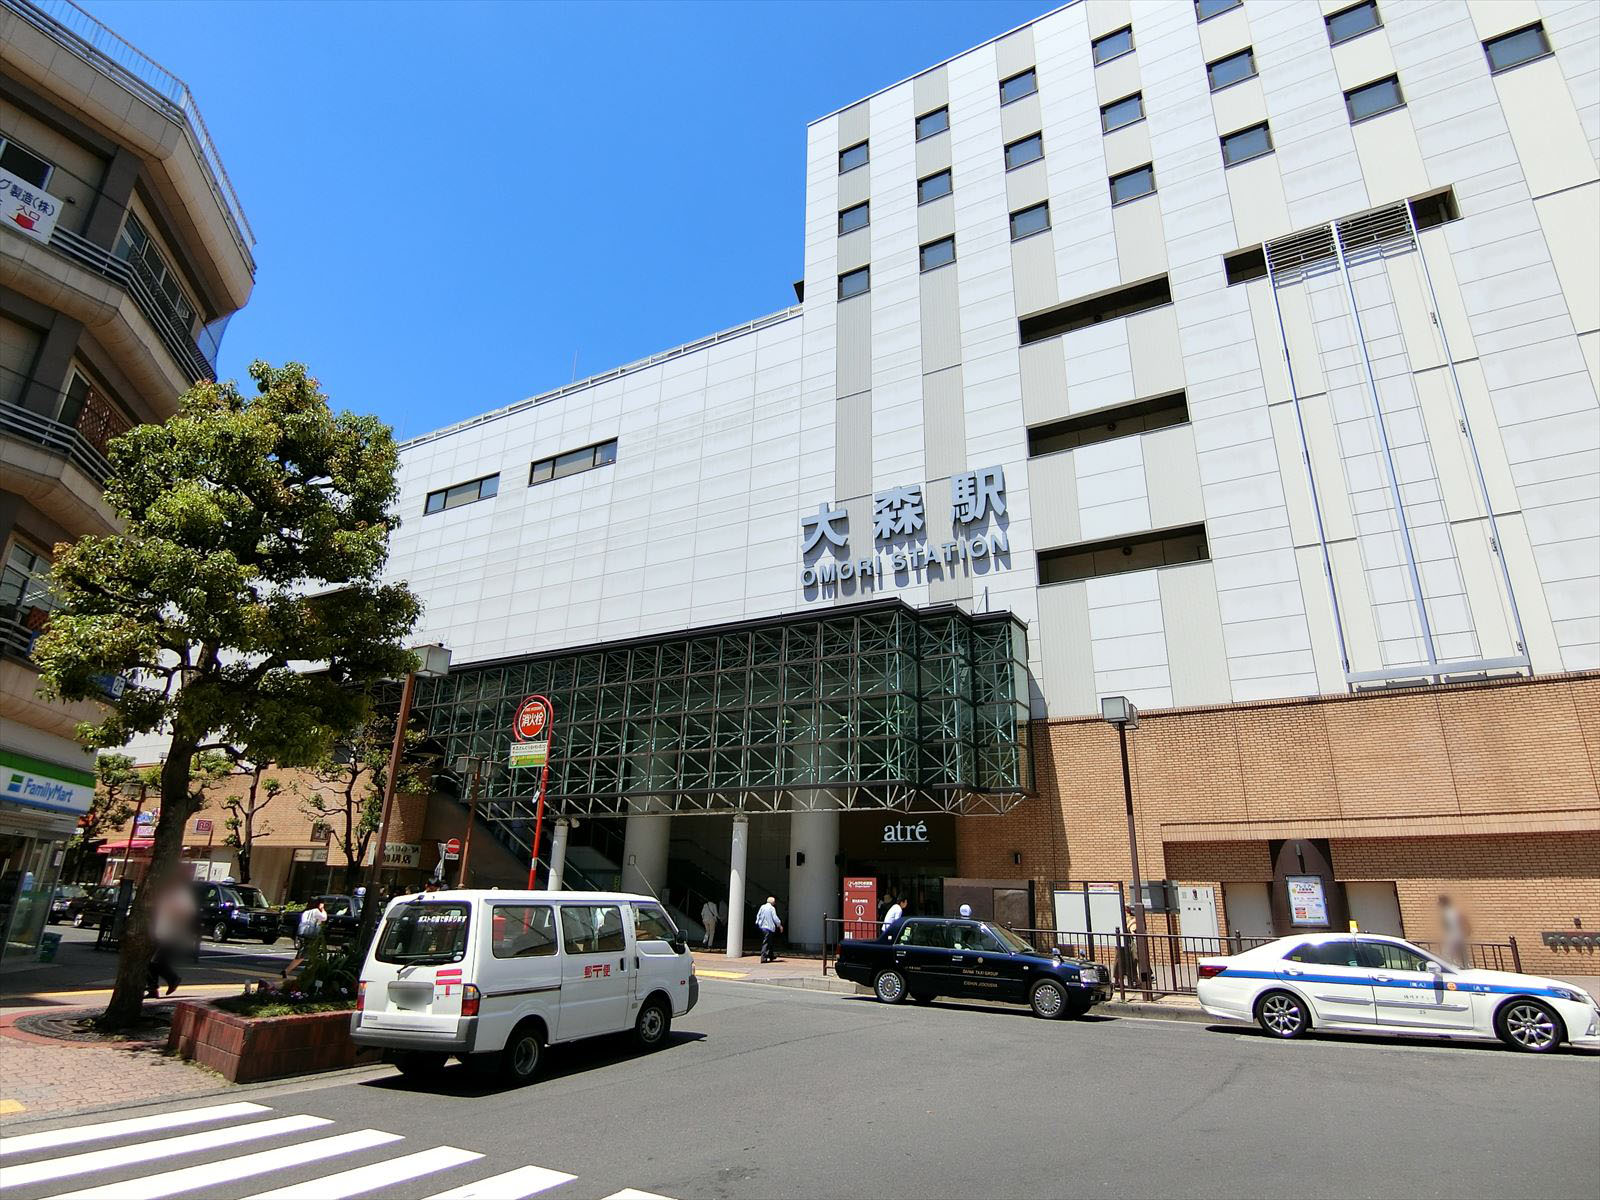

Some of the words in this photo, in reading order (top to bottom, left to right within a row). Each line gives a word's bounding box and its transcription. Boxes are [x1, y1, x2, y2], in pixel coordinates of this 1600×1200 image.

[800, 465, 1006, 555] 大森駅
[892, 533, 1008, 571] STATION
[521, 711, 544, 727] 消火栓
[24, 777, 73, 803] FamilyMart
[883, 820, 928, 841] atré
